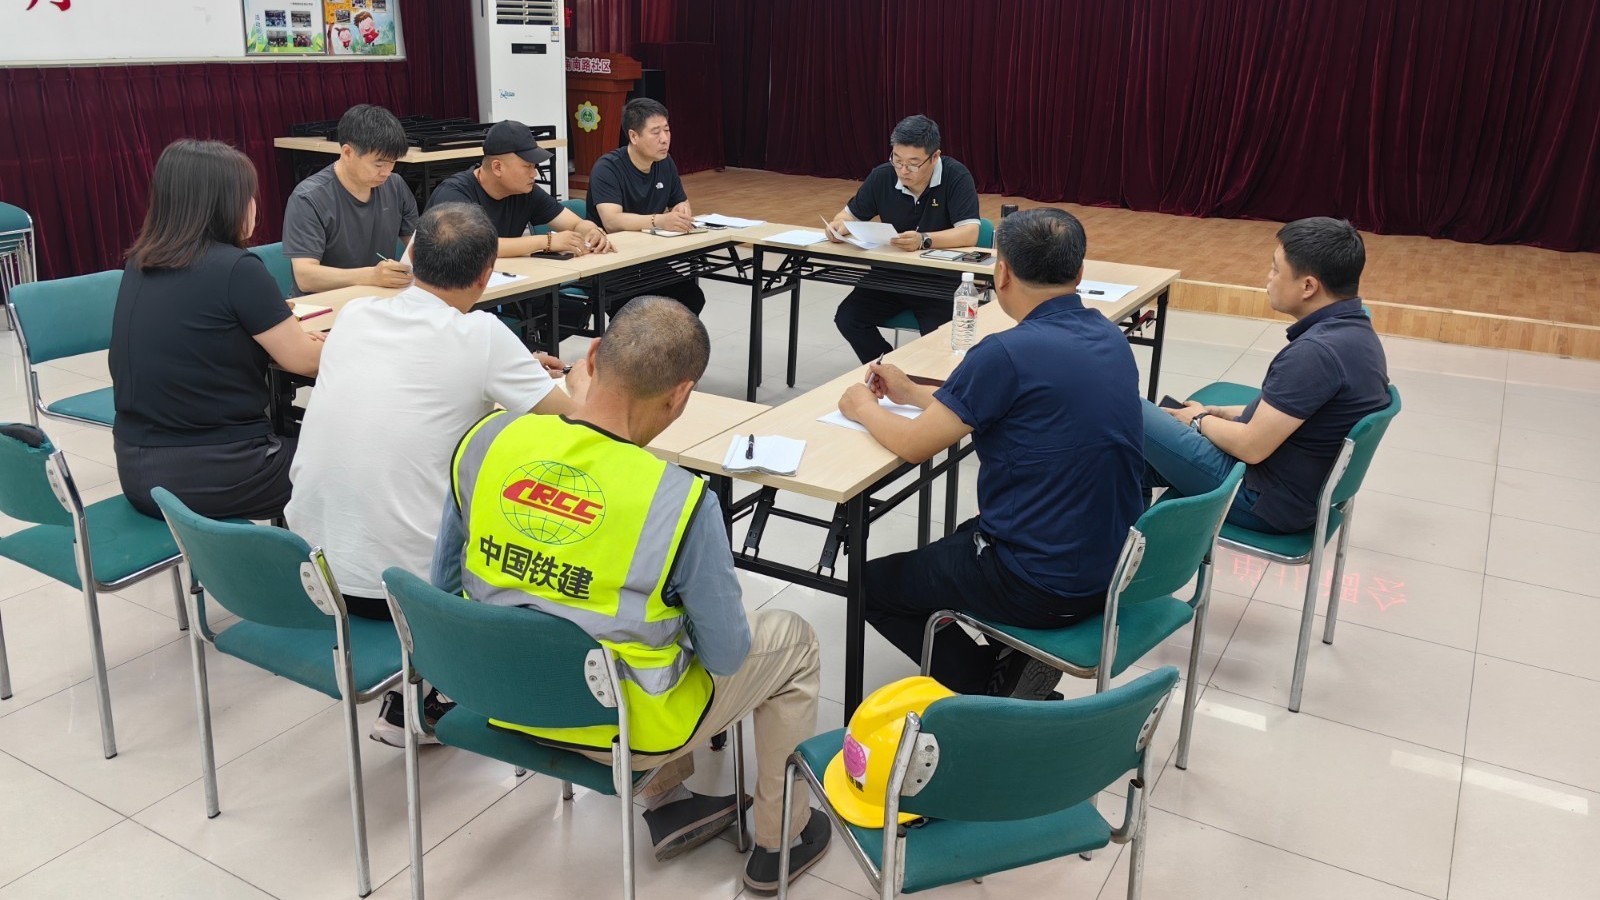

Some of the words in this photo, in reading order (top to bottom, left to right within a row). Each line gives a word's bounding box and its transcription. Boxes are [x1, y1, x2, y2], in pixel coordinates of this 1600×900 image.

[503, 479, 603, 525] CRCC
[480, 535, 593, 600] 中国铁建
